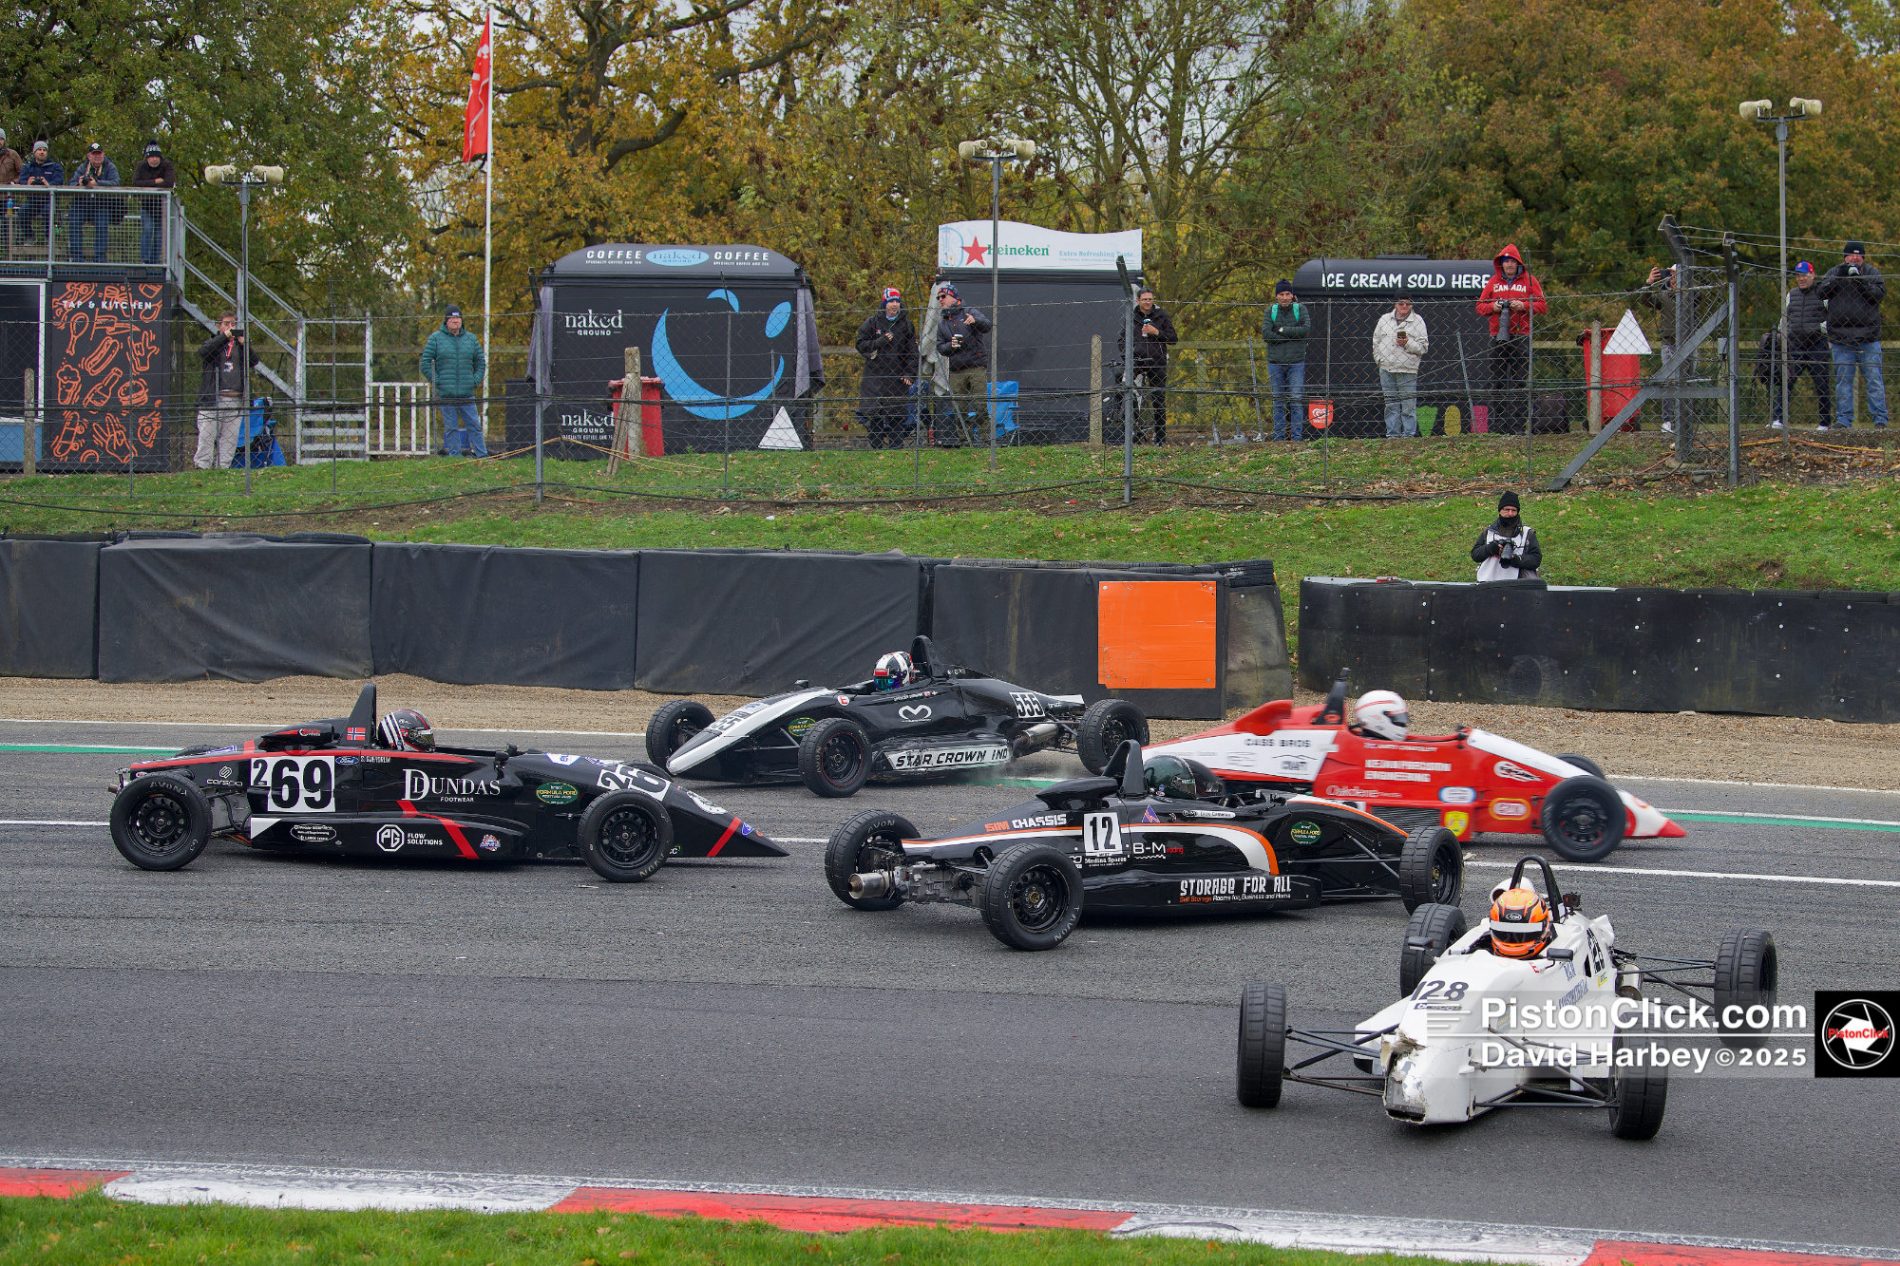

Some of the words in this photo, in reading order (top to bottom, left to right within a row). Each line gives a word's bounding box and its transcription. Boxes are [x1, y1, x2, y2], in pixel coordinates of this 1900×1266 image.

[587, 250, 642, 259] COFFEE
[714, 251, 769, 261] COFFEE
[1321, 273, 1345, 288] ICE
[1350, 273, 1402, 289] CREAM
[1407, 273, 1446, 289] SOLD
[1451, 273, 1490, 289] HERE
[61, 300, 83, 309] TAP
[88, 301, 96, 309] &
[101, 301, 152, 309] KITCHEN
[565, 309, 623, 329] naked
[561, 409, 615, 427] naked
[1013, 693, 1044, 717] 555
[896, 754, 932, 767] STAR
[936, 750, 986, 764] CROWN
[253, 758, 332, 810] 269
[401, 768, 501, 801] DUNDAS
[984, 820, 1010, 832] SIM
[1012, 813, 1067, 829] CHASSIS
[1089, 816, 1116, 851] 12
[1180, 877, 1236, 897] STORAGE
[1243, 876, 1266, 894] FOR
[1273, 875, 1292, 893] ALL
[1410, 979, 1469, 1002] 128
